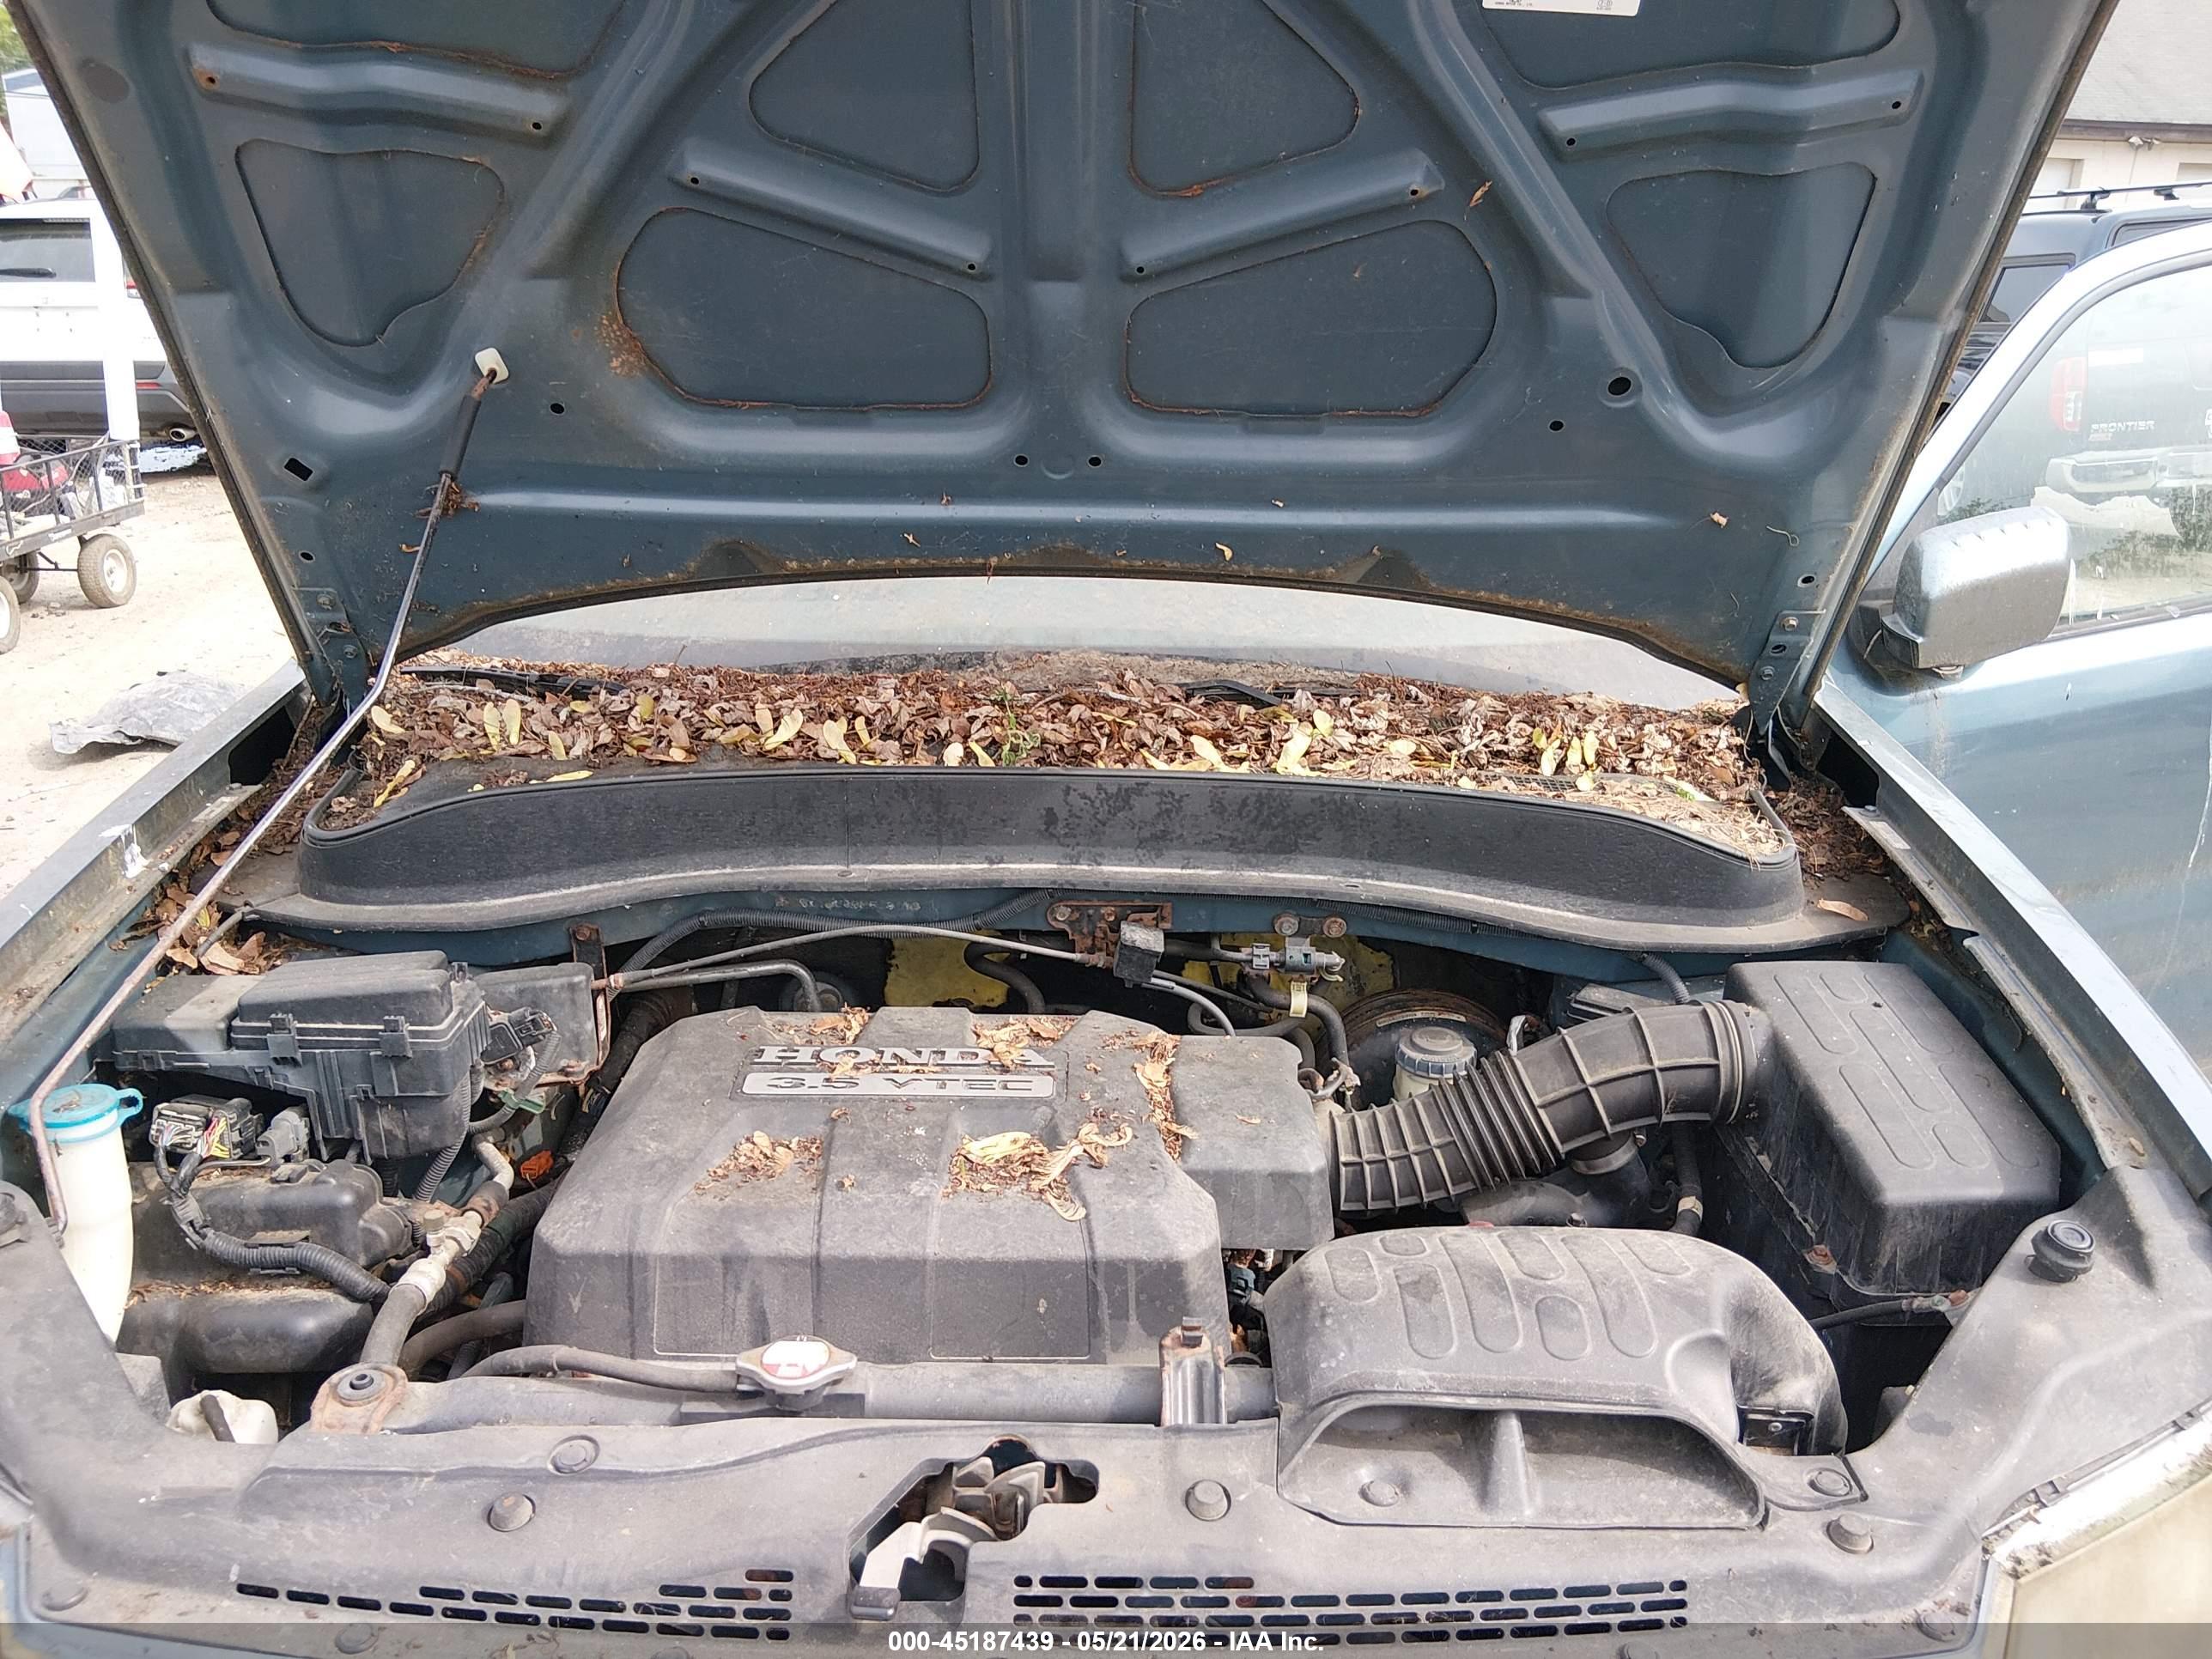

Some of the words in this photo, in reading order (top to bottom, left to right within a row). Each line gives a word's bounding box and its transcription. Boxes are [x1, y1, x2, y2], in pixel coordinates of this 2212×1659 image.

[2090, 419, 2156, 433] FRONTIER
[766, 1076, 860, 1090] 3.5
[882, 1077, 1035, 1091] VTEC
